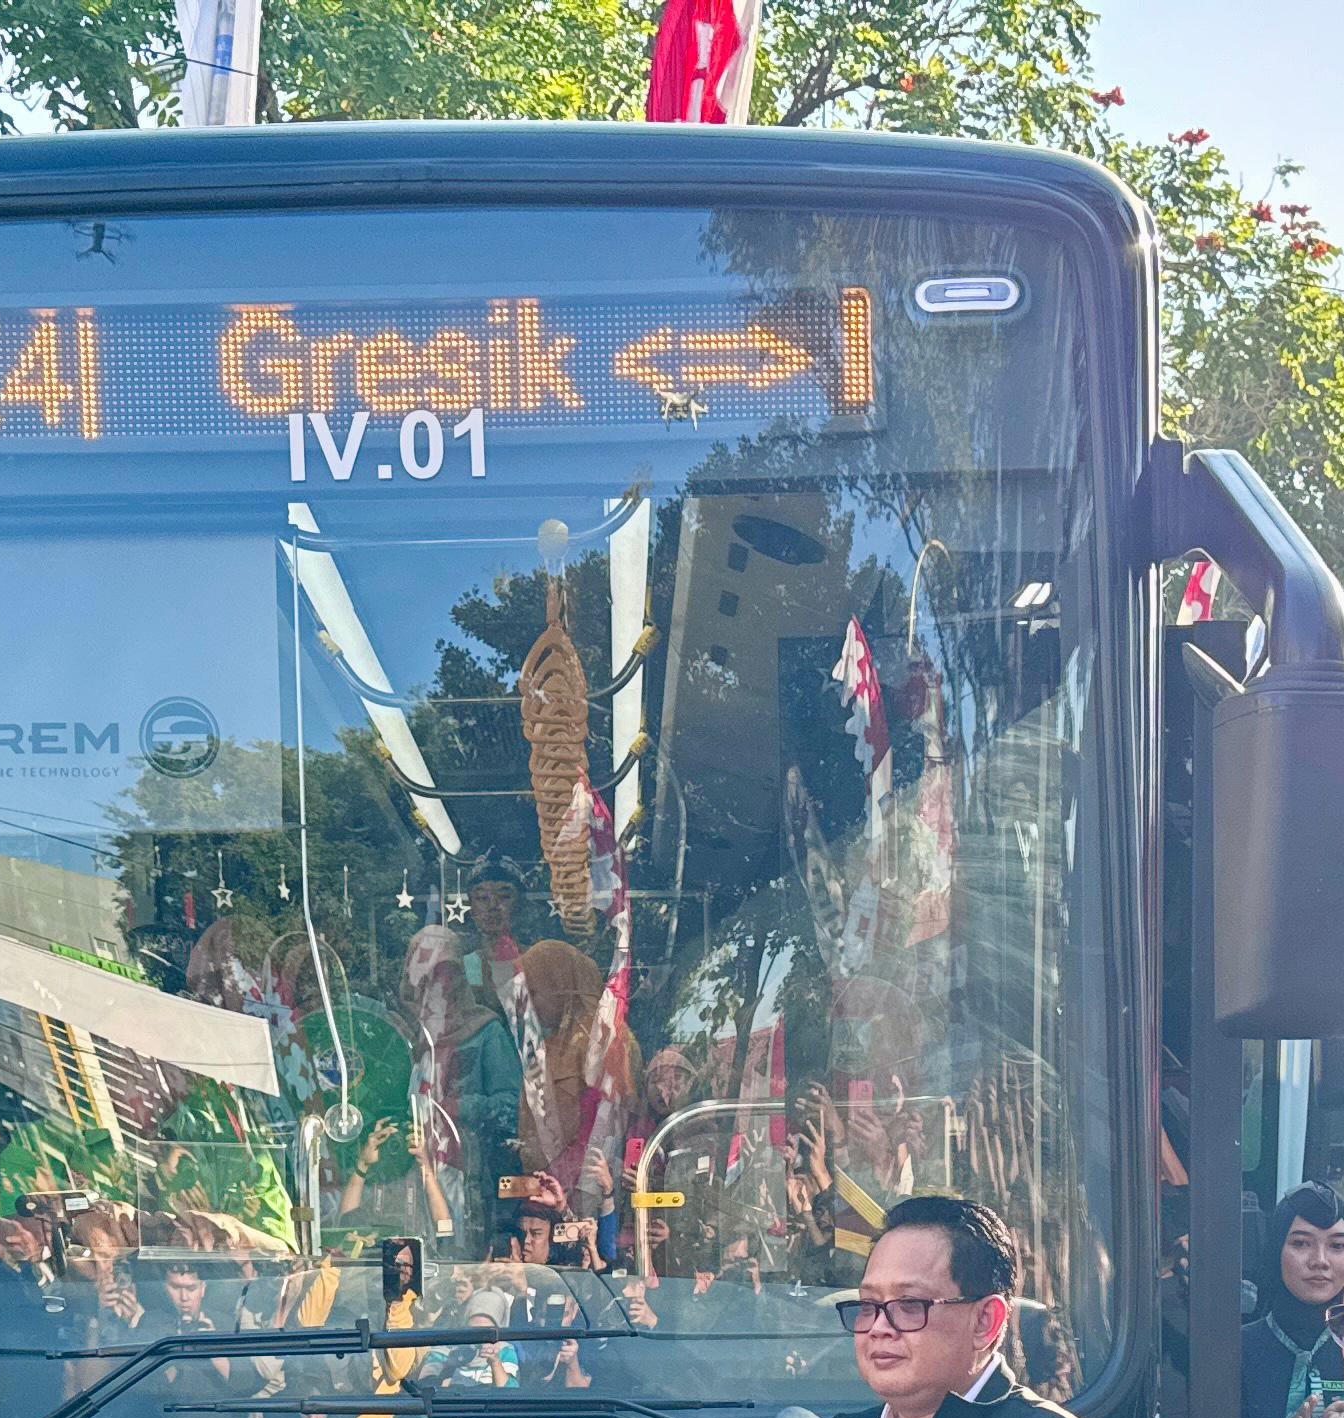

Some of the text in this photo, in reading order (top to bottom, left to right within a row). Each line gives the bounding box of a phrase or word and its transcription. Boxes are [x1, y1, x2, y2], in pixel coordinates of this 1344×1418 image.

[219, 298, 585, 416] Gresik
[289, 408, 487, 483] IV.01
[20, 766, 121, 779] TECHNOLOGY
